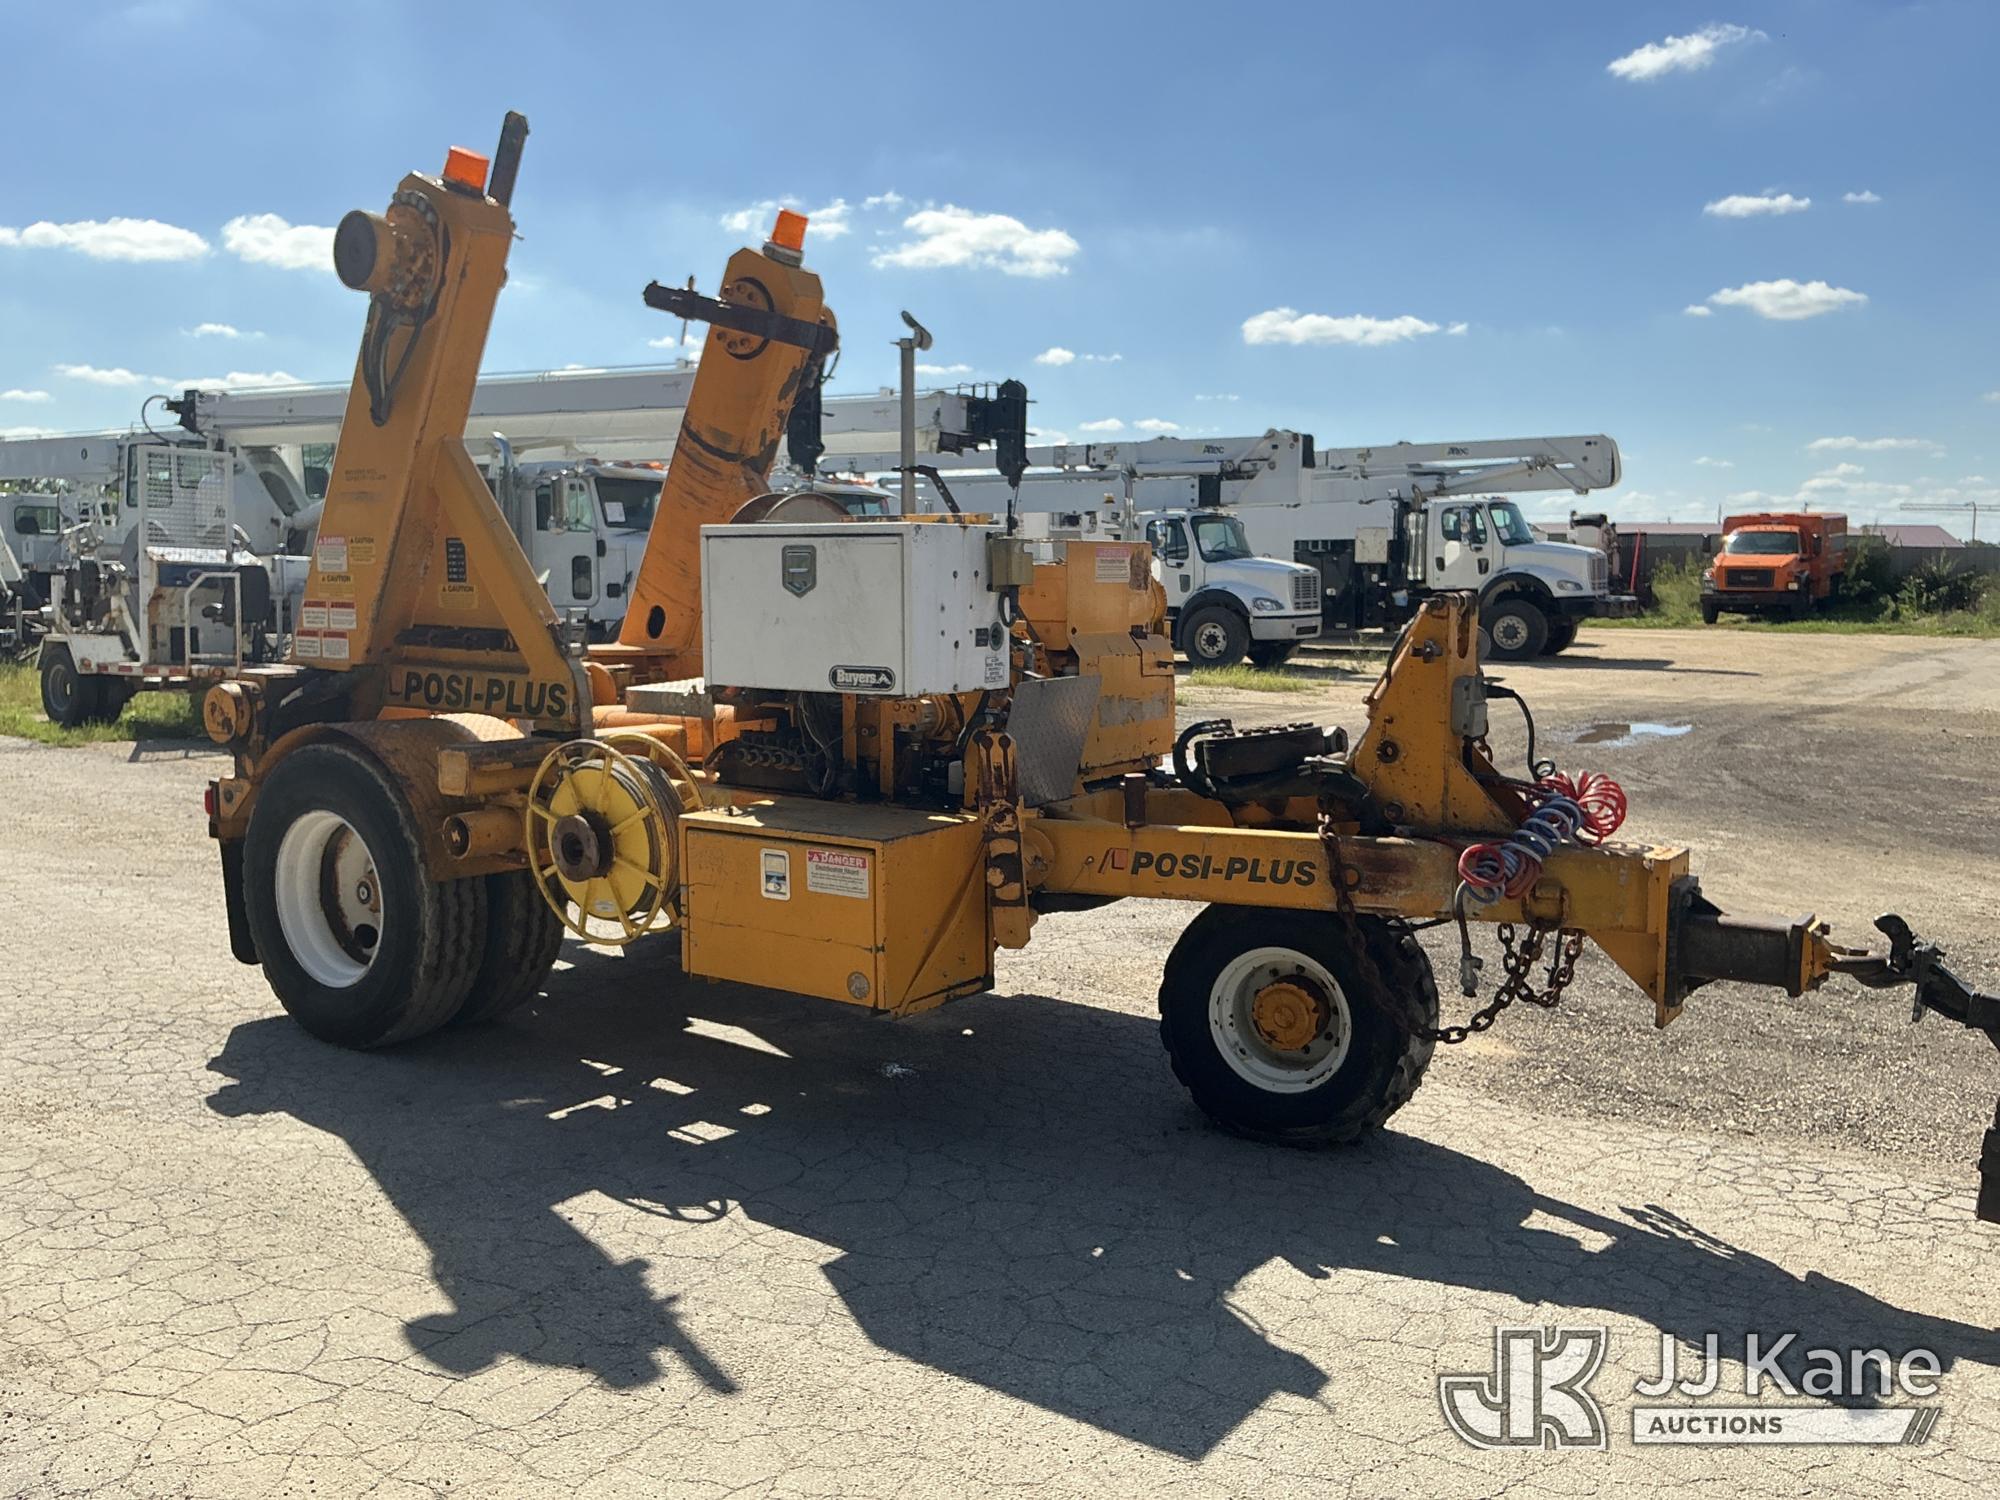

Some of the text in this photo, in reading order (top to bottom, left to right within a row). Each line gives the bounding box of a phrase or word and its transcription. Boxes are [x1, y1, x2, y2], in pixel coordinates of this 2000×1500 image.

[836, 669, 877, 686] Buyers
[404, 671, 567, 717] POSI-PLUS
[820, 852, 864, 868] DANGER
[1131, 851, 1317, 887] POSI-PLUS
